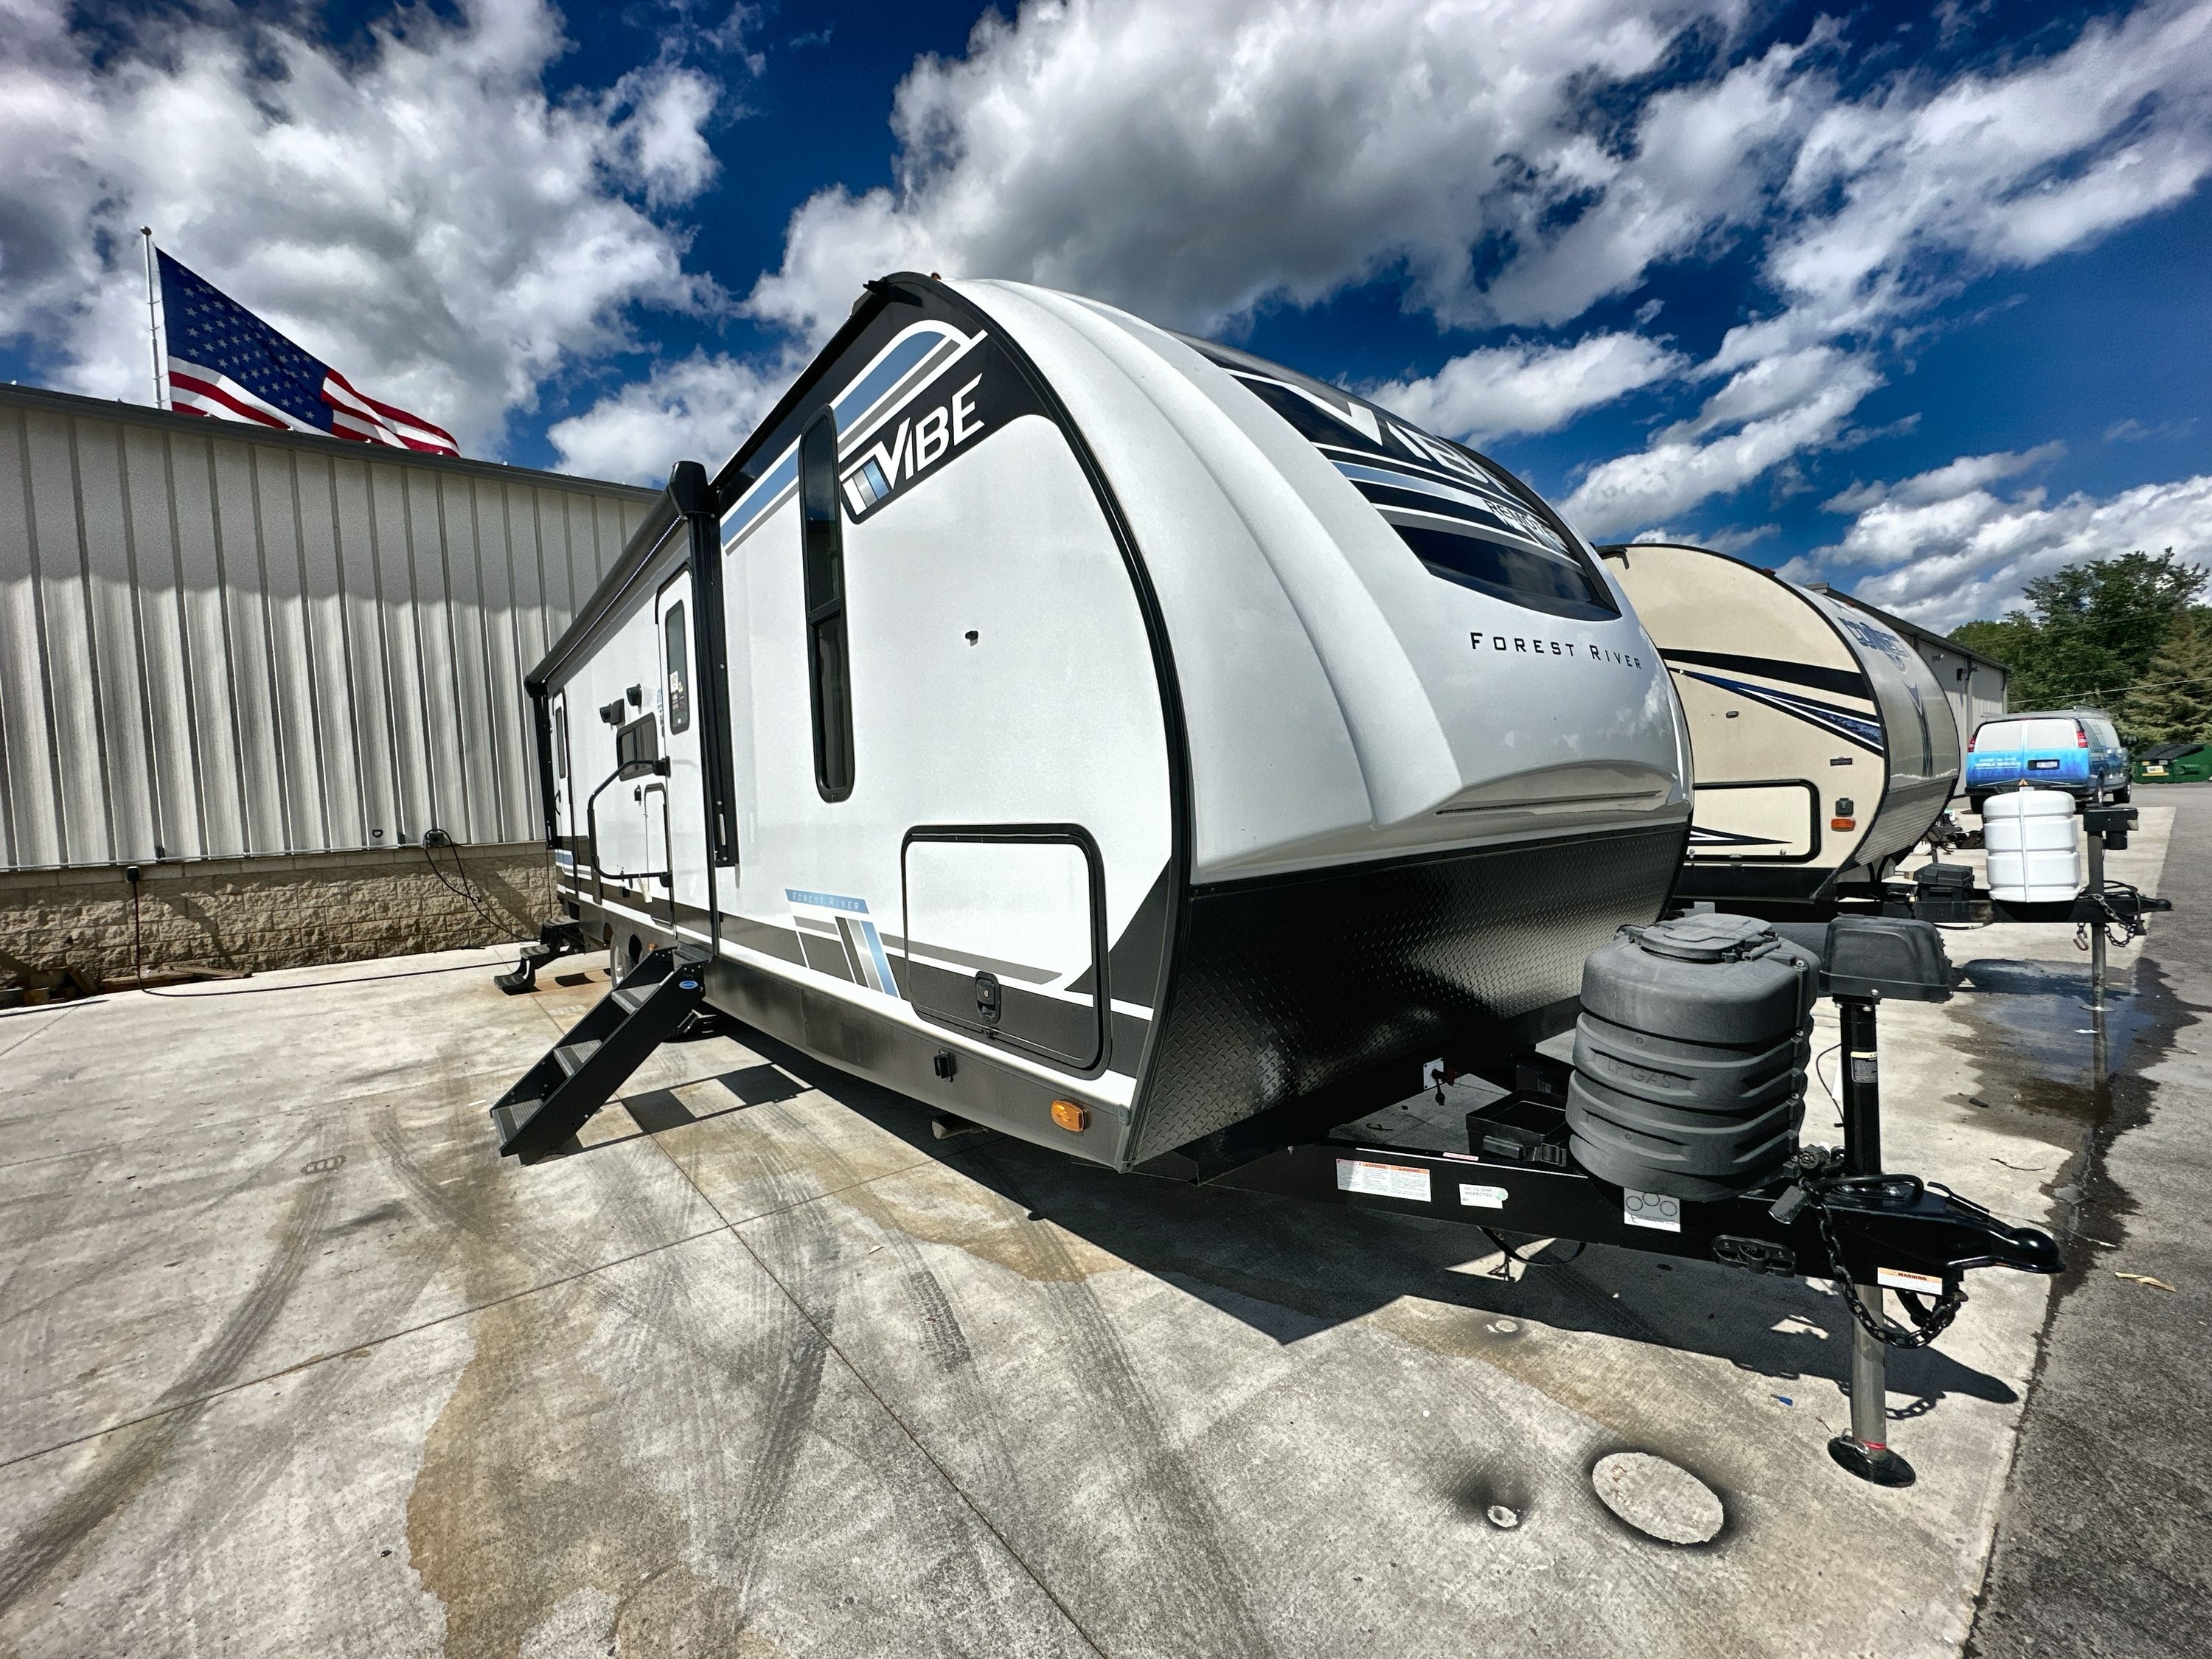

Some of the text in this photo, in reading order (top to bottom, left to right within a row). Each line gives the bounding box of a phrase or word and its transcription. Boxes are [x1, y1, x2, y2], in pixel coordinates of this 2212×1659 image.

[870, 372, 986, 490] VIBE
[1470, 632, 1641, 669] FOREST RIVER
[793, 892, 859, 910] FOREST RIVER
[1630, 1068, 1672, 1088] GAS
[1897, 1272, 1927, 1281] WARNING
